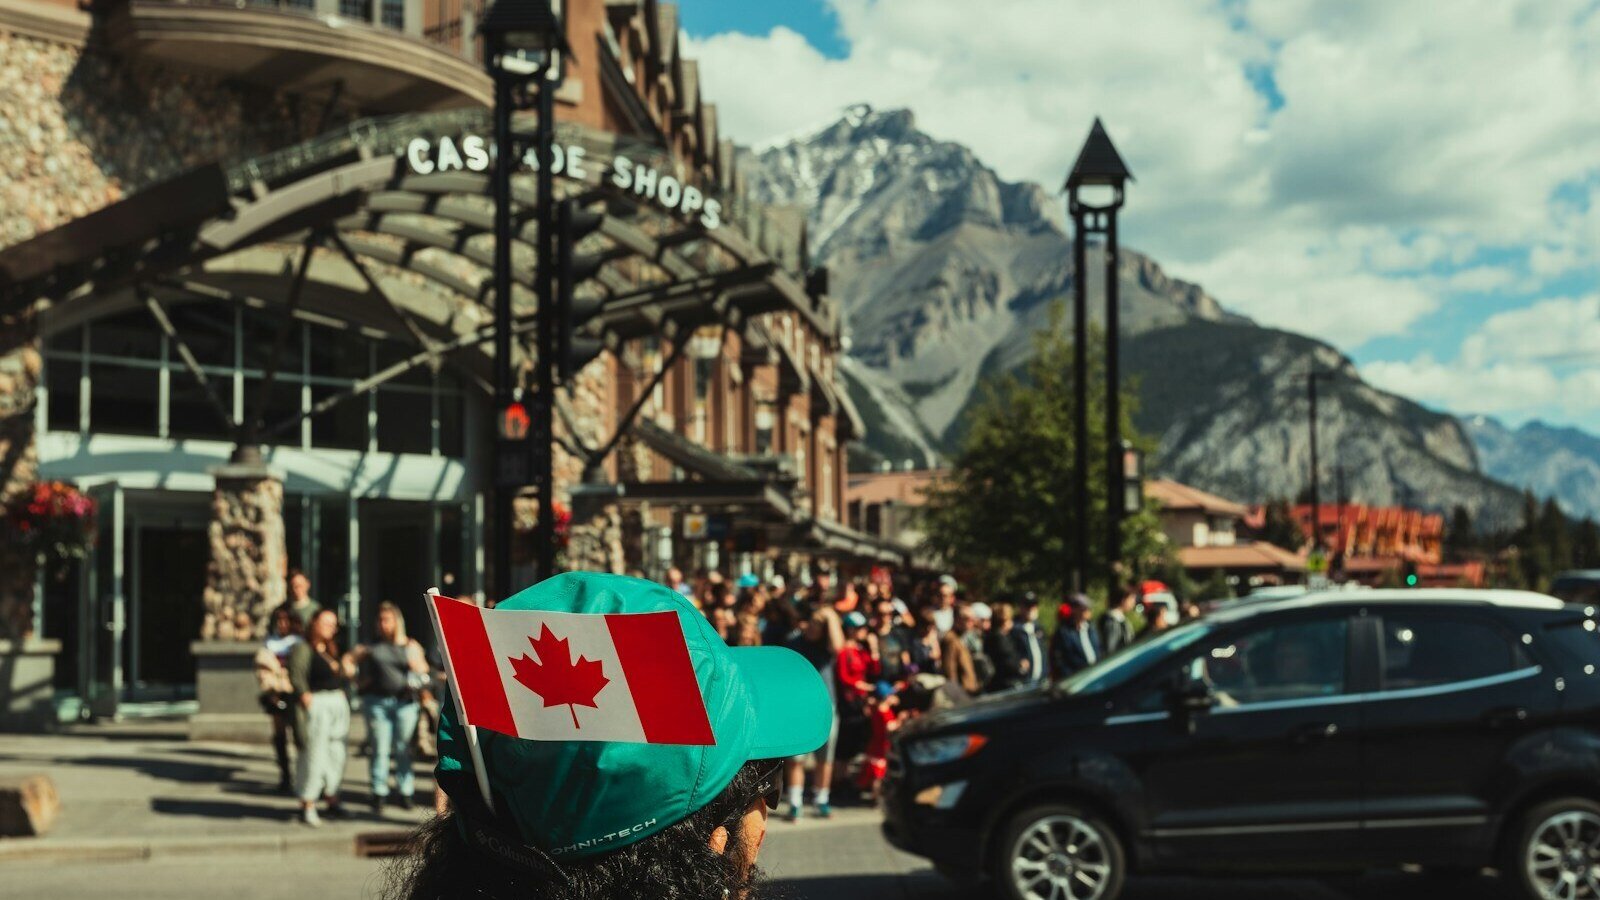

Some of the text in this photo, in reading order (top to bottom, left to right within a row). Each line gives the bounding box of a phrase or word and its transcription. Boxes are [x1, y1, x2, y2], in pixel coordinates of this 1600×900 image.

[407, 135, 721, 230] CASADE SHOPS
[488, 836, 551, 875] Columbi
[552, 817, 657, 855] OMNI-TECH
